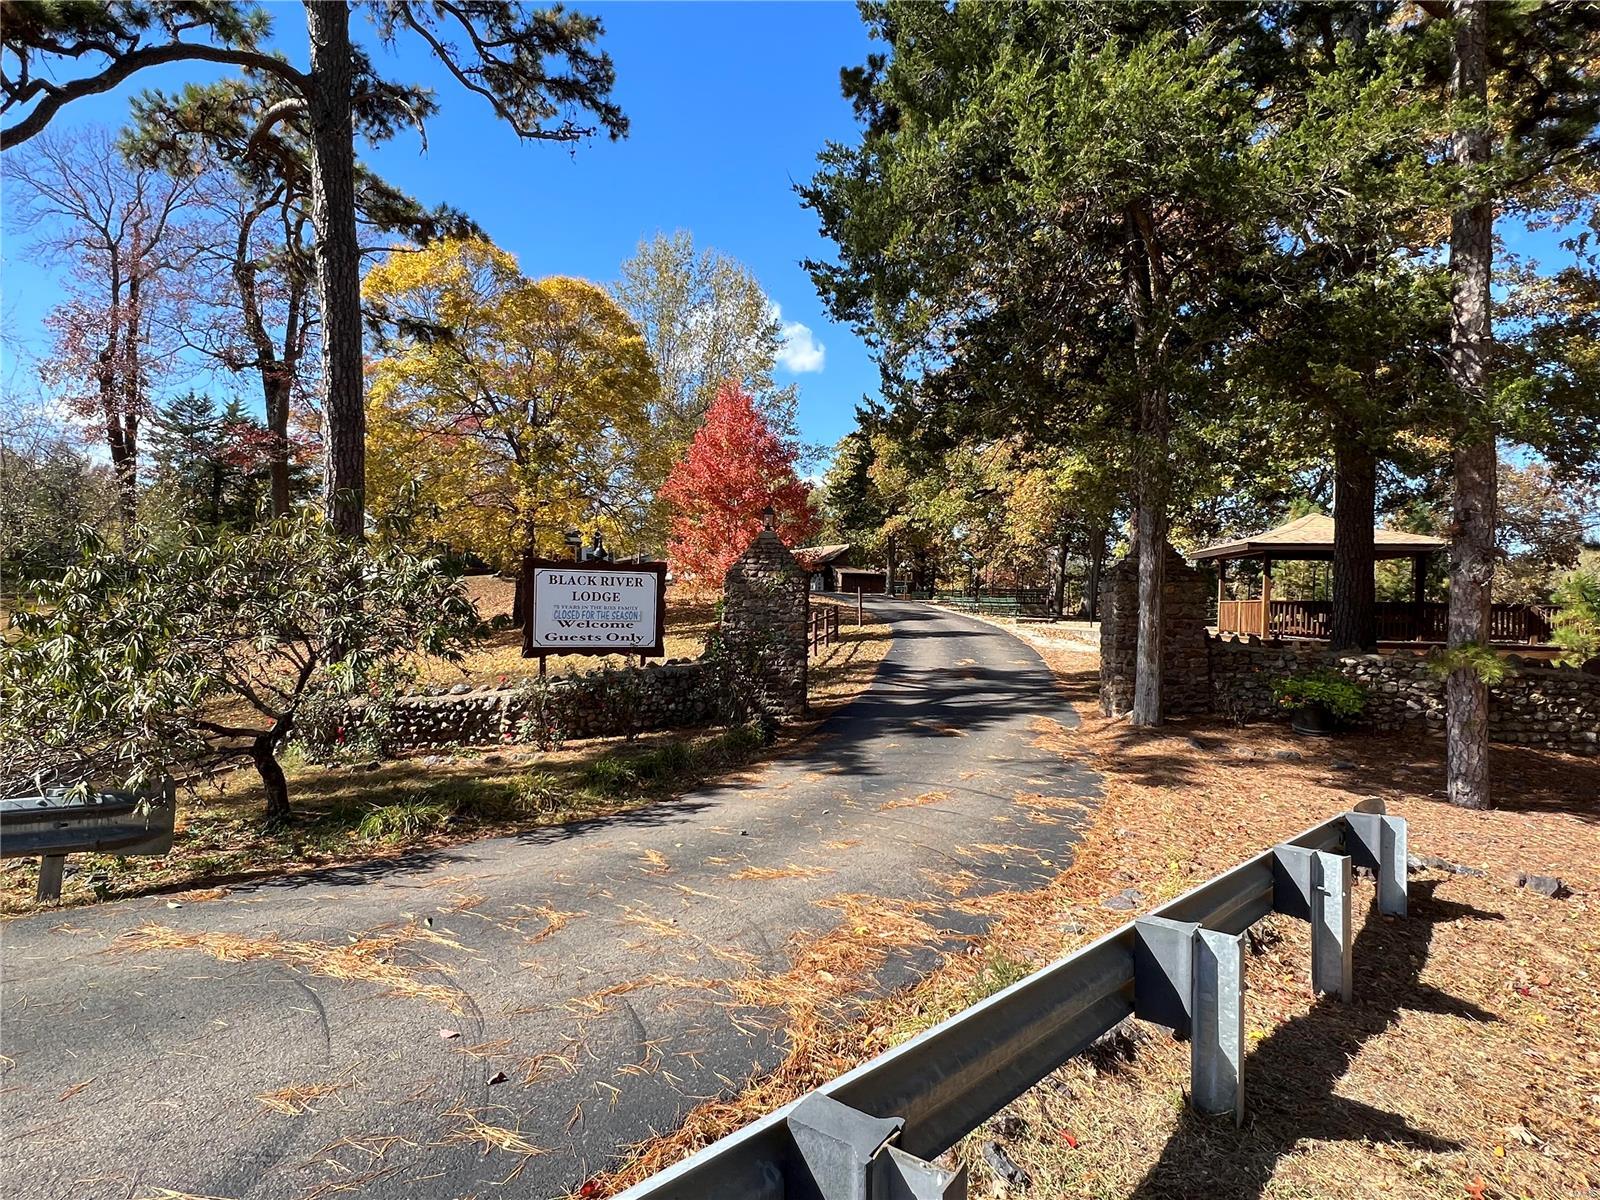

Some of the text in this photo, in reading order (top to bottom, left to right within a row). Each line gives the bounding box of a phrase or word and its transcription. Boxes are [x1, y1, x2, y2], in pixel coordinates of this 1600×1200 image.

[548, 574, 644, 587] BLACK RIVER
[572, 591, 621, 602] LODGE
[553, 610, 638, 620] CLOSED FOR THE SEASON
[557, 620, 634, 629] Welcome
[544, 632, 644, 644] Guests Only
